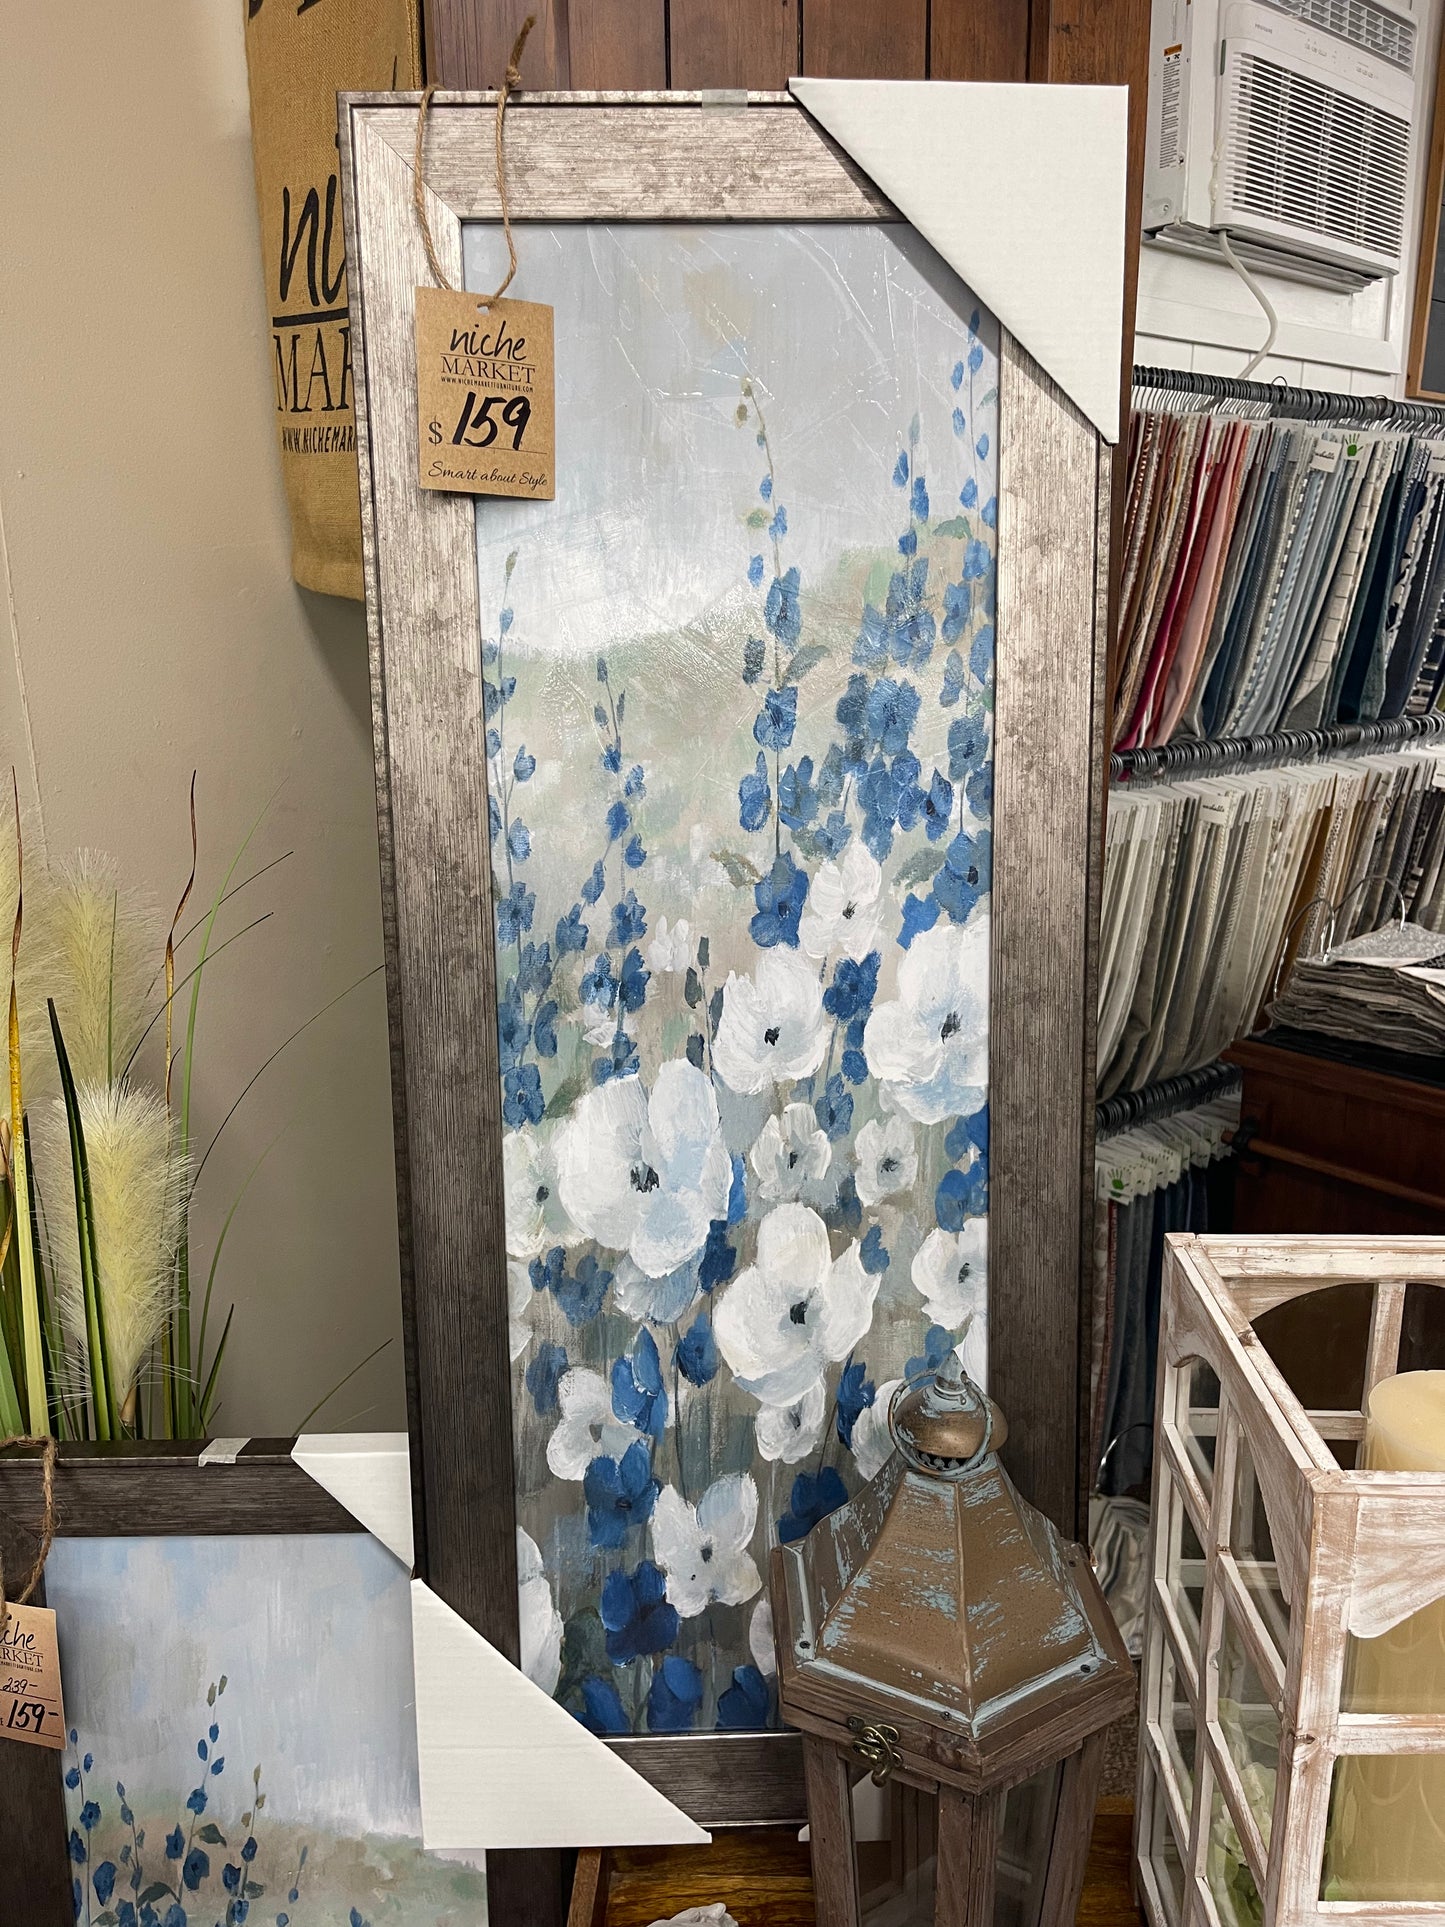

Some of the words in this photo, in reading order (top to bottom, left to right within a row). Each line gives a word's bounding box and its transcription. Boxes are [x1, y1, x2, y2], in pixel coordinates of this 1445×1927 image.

[449, 320, 527, 361] niche
[440, 355, 536, 384] MARKET
[428, 415, 443, 447] $
[451, 391, 532, 451] 159
[281, 425, 356, 454] WWW.NICHEMAR
[427, 460, 478, 481] Smart
[480, 467, 516, 483] about
[518, 471, 548, 491] Style
[0, 1647, 44, 1668] RKET
